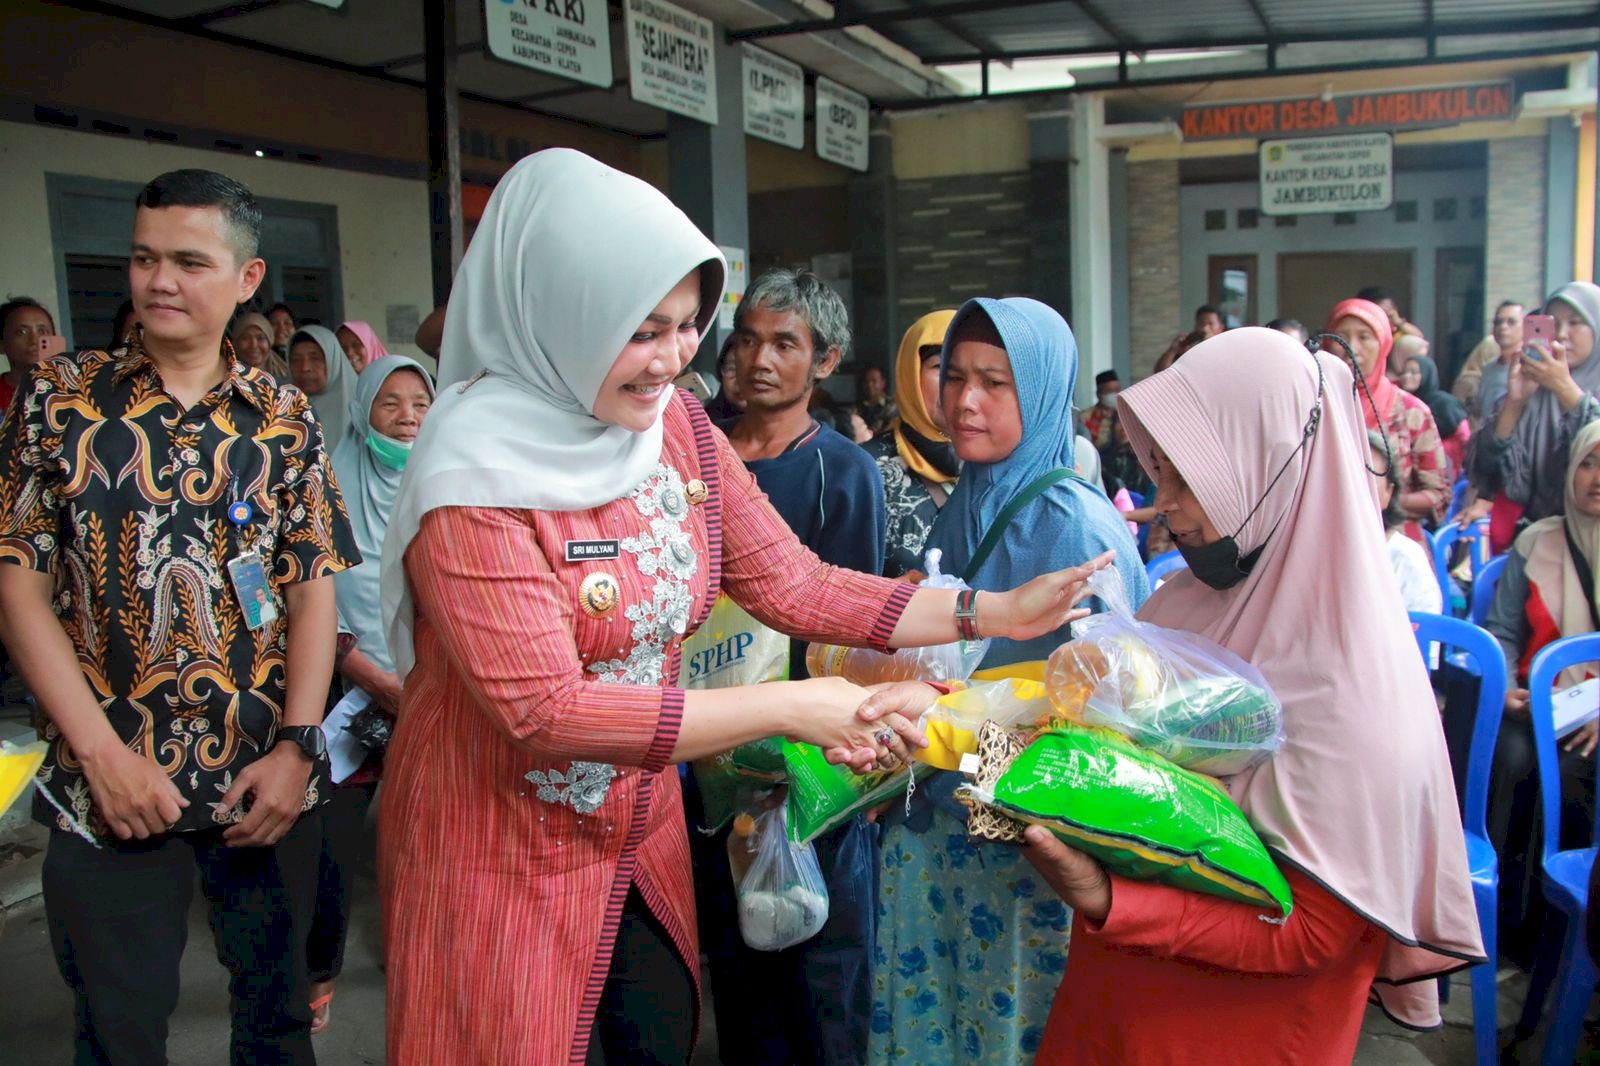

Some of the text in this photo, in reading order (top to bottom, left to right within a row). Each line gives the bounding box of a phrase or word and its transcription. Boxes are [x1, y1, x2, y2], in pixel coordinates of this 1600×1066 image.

[510, 10, 528, 25] DESA
[511, 28, 551, 48] KECAMATAN
[512, 44, 551, 64] KABUPATEN
[1184, 86, 1509, 138] KANTOR DESA JAMBUKULON
[1265, 162, 1387, 183] KANTOR KEPALA DESA
[1273, 182, 1382, 204] JAMBUKULON
[572, 544, 615, 555] SRI MULYANI
[689, 632, 754, 678] SPHP
